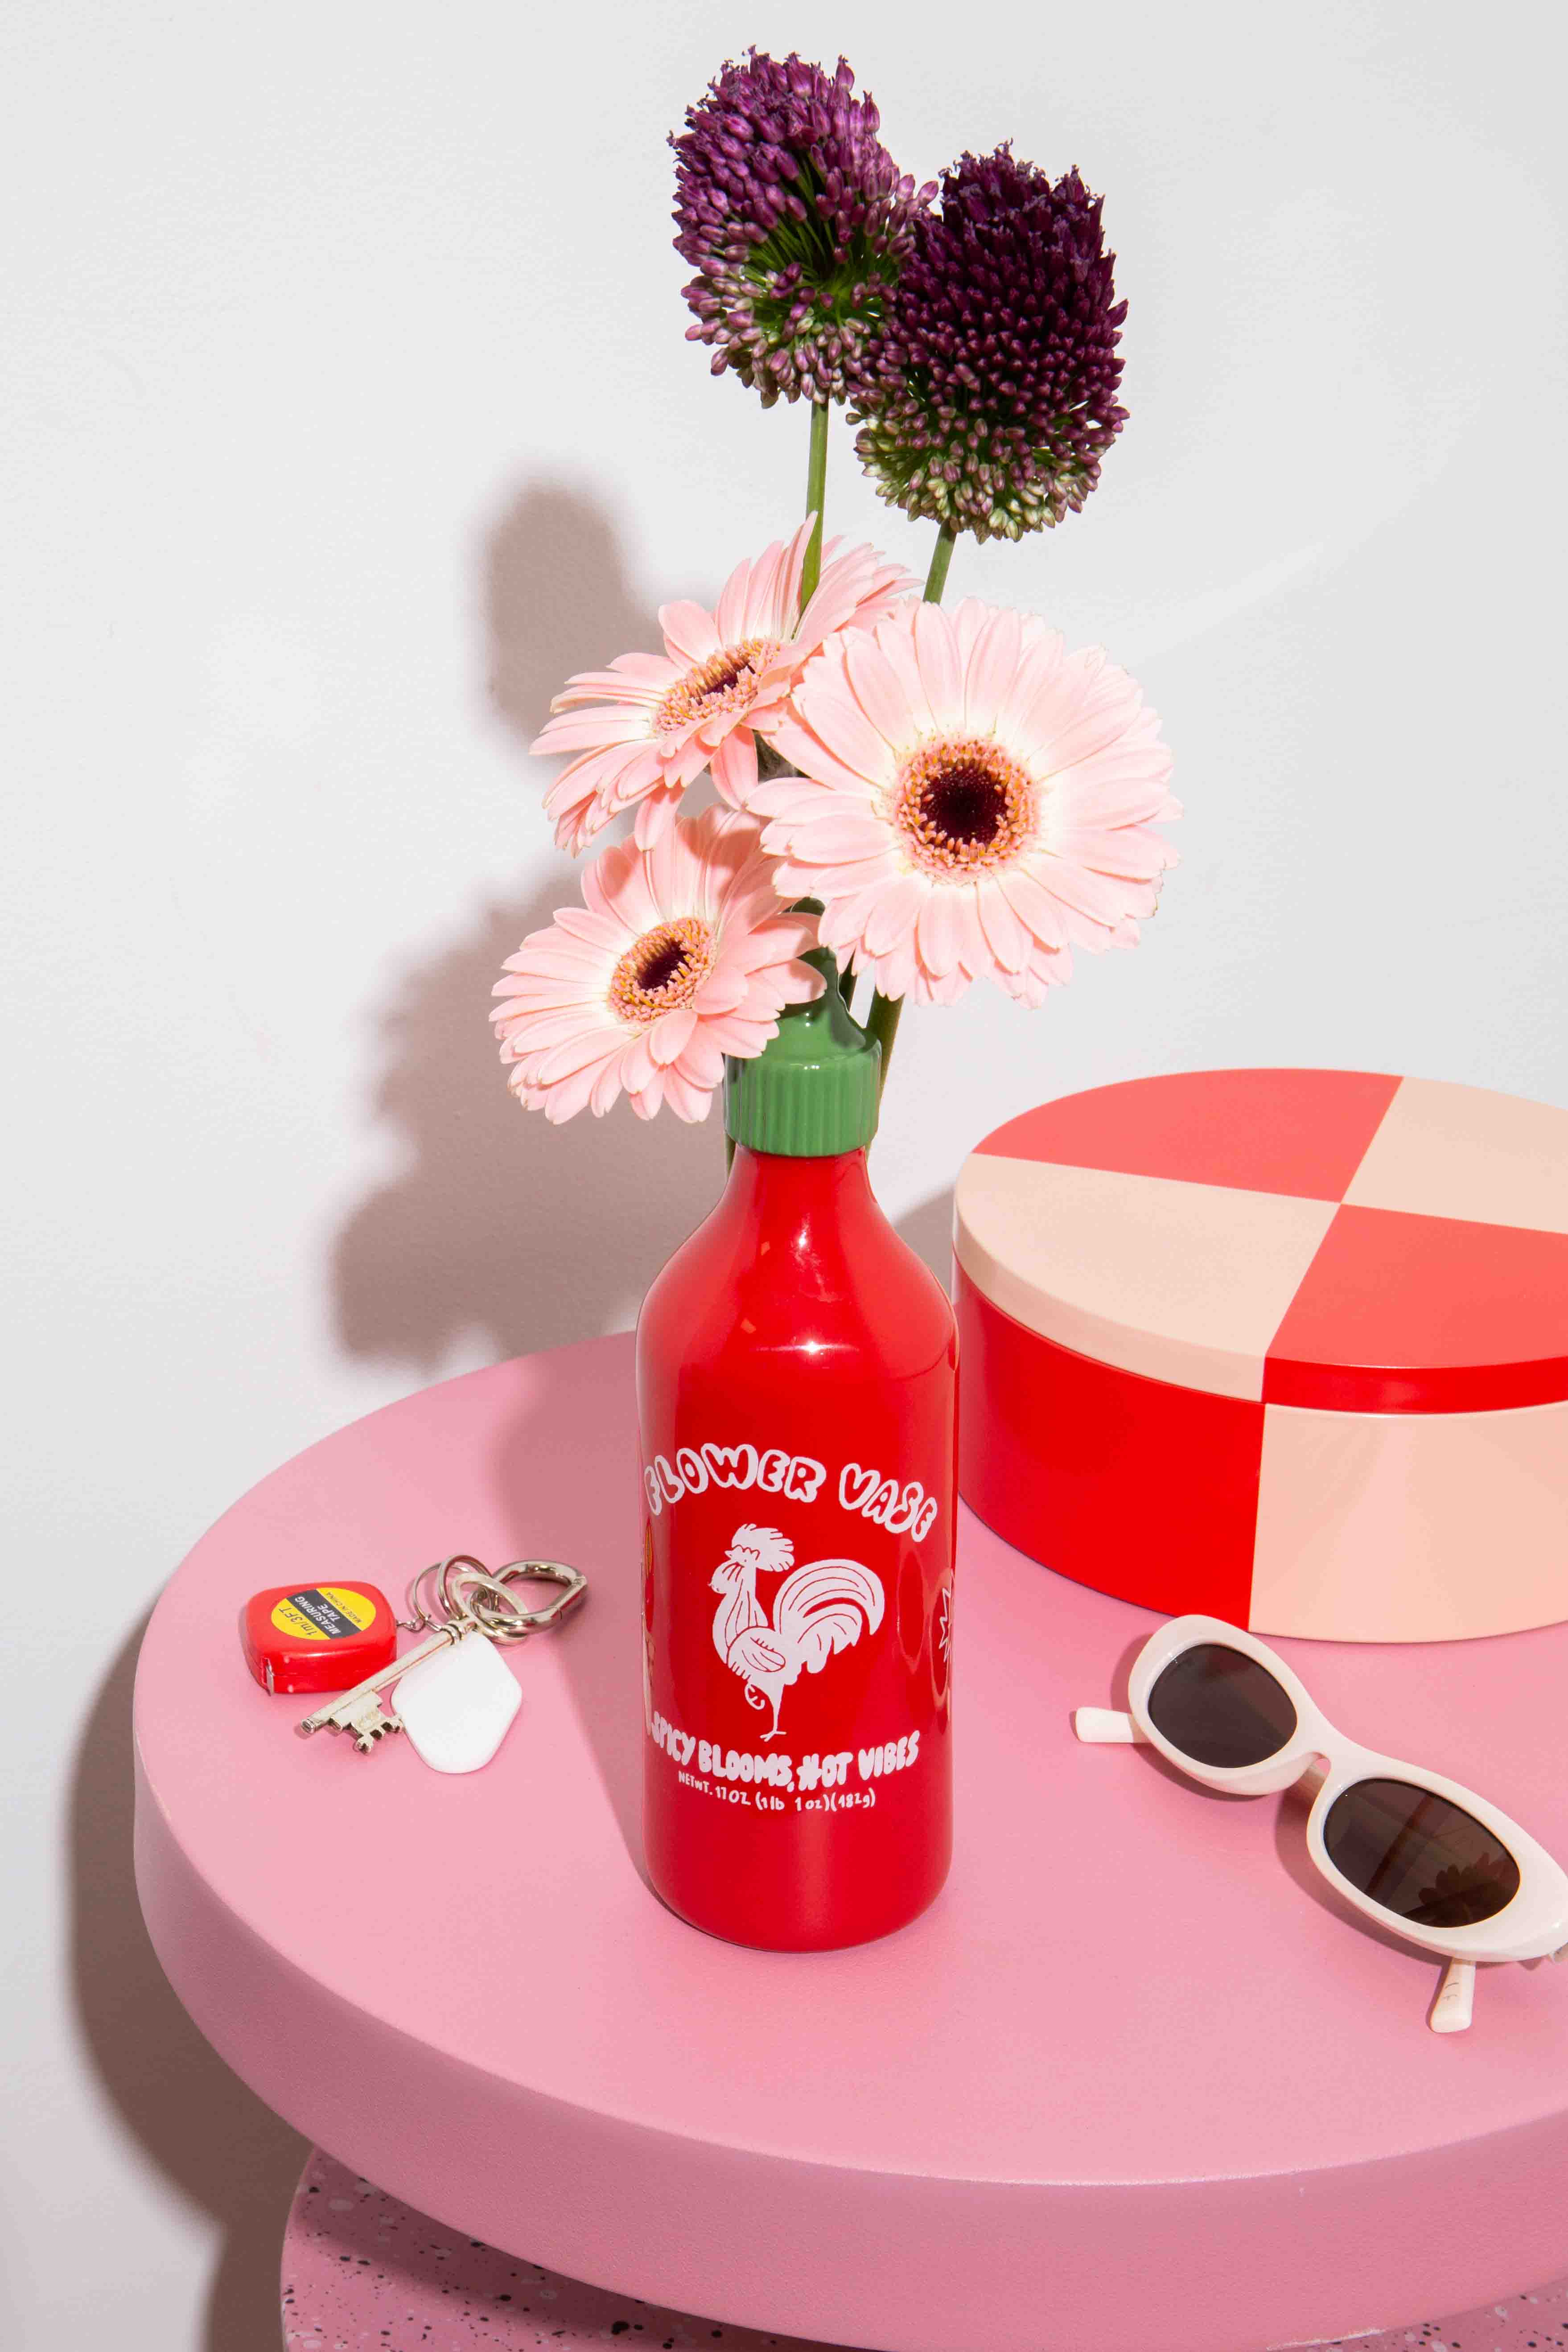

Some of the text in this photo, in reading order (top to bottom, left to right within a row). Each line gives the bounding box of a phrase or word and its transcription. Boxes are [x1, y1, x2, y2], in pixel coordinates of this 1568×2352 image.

[644, 1443, 938, 1542] FLOWER VASE
[279, 1607, 317, 1636] 1m/3FT
[294, 1596, 342, 1635] MEASURING
[317, 1604, 340, 1621] TAPE
[652, 1711, 696, 1765] SPICY
[797, 1752, 853, 1791] HOT
[858, 1730, 920, 1780] VIBES
